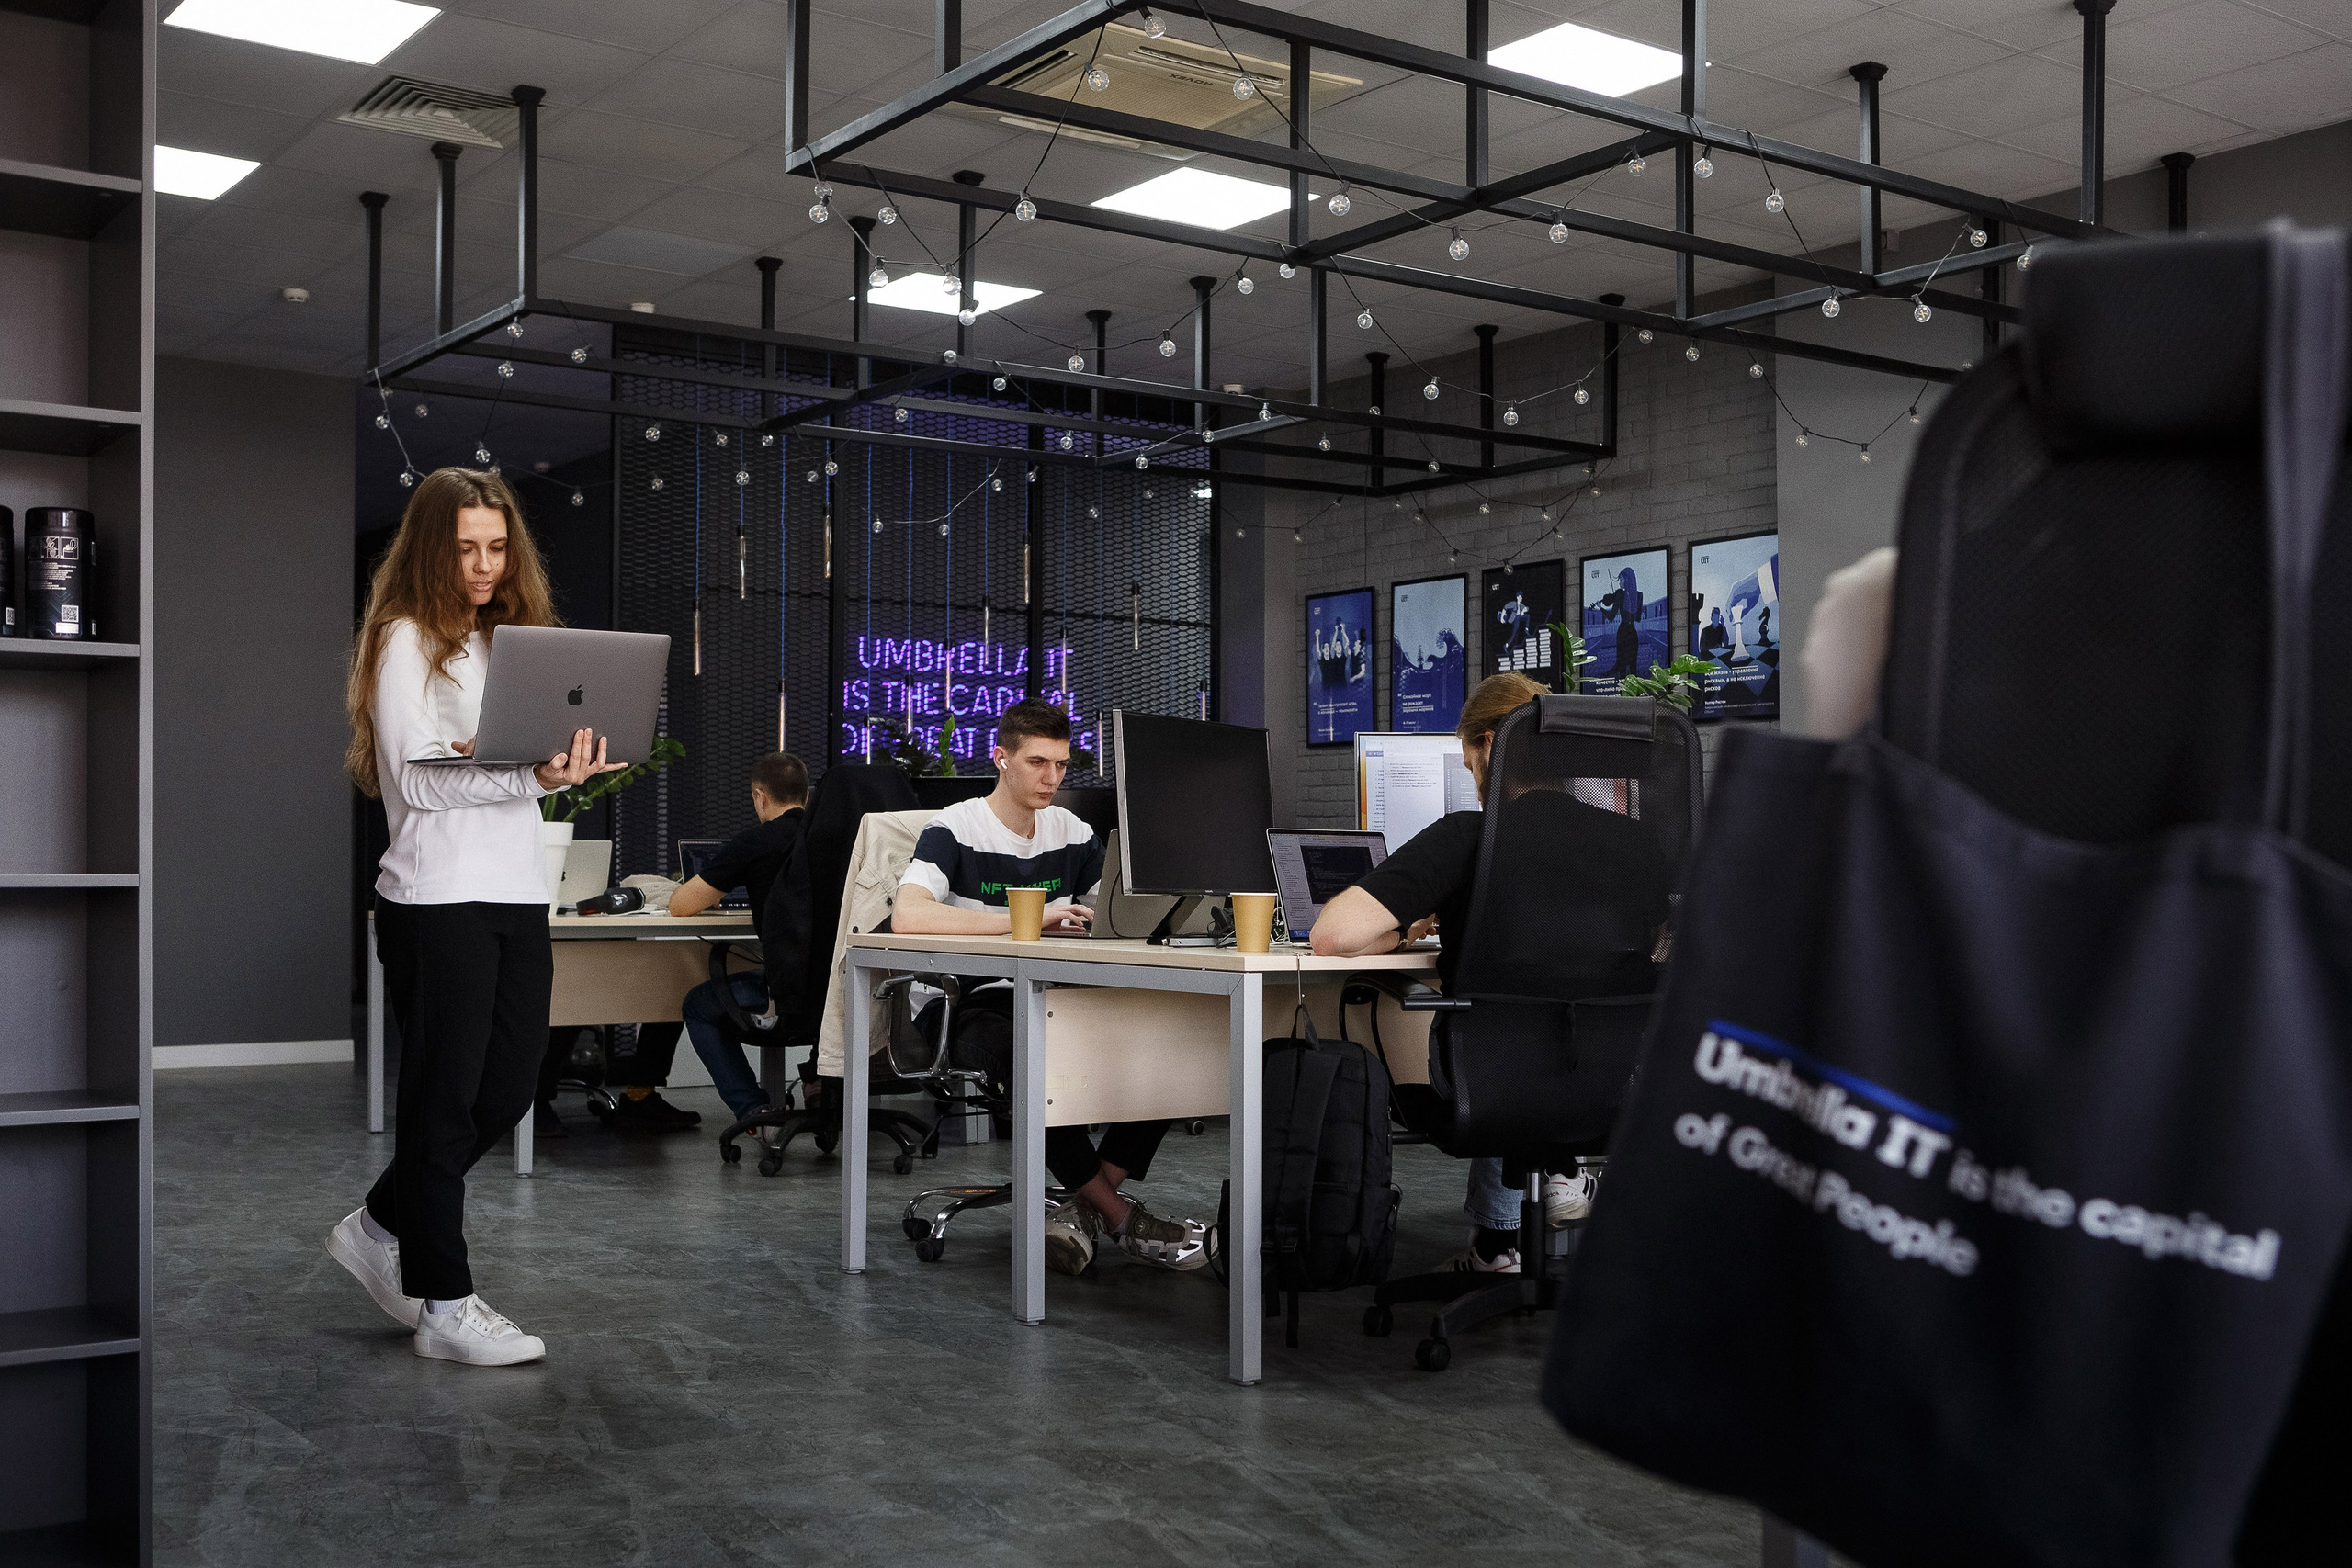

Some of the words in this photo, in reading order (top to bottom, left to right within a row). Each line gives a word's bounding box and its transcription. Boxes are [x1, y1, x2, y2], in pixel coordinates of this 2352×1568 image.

[843, 680, 870, 711] IS
[882, 680, 940, 714] THE
[1673, 1111, 1733, 1158] of
[1814, 1168, 1982, 1278] People
[1872, 1113, 1953, 1179] IT
[1949, 1147, 1989, 1201] is
[1989, 1165, 2076, 1229] the
[2078, 1194, 2283, 1282] capital
